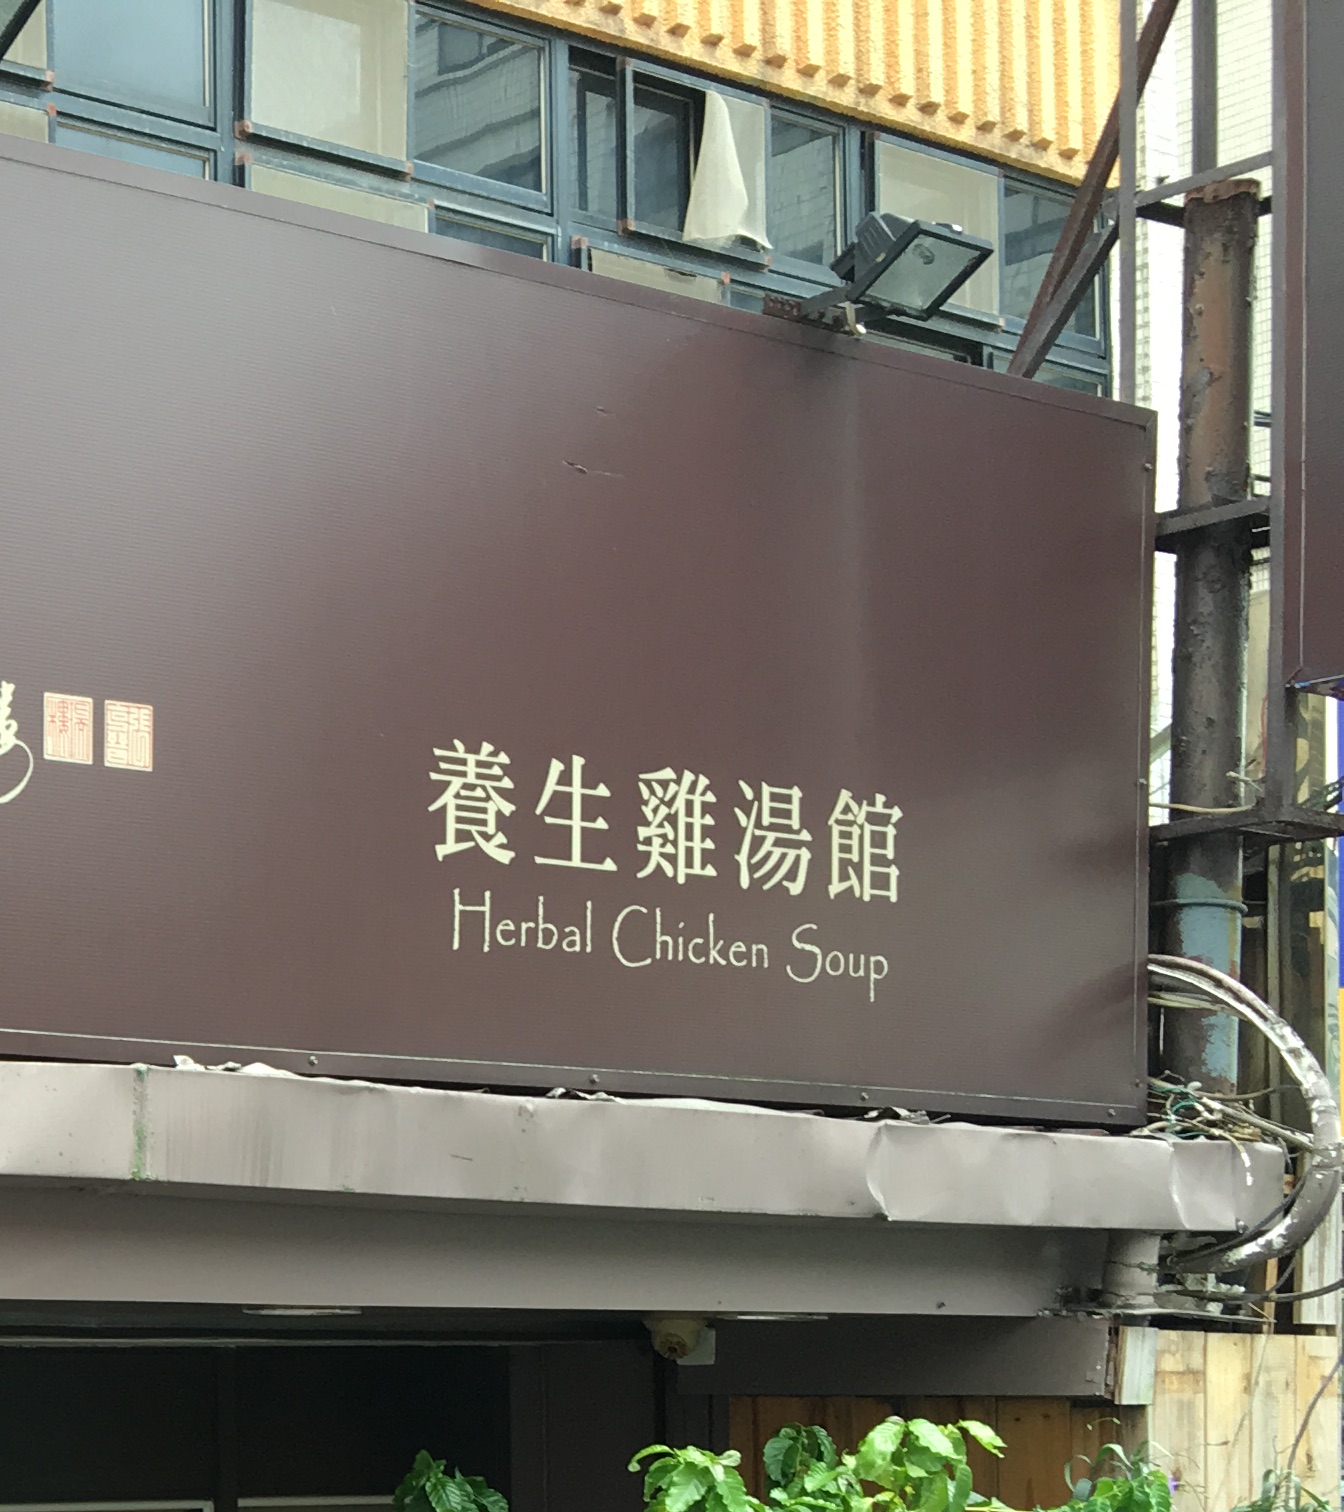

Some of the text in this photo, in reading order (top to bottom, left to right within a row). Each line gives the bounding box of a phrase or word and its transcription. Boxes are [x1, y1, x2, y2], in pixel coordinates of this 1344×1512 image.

[427, 738, 903, 903] 養生雞湯館
[451, 887, 889, 1002] Herbal Chicken Soup
